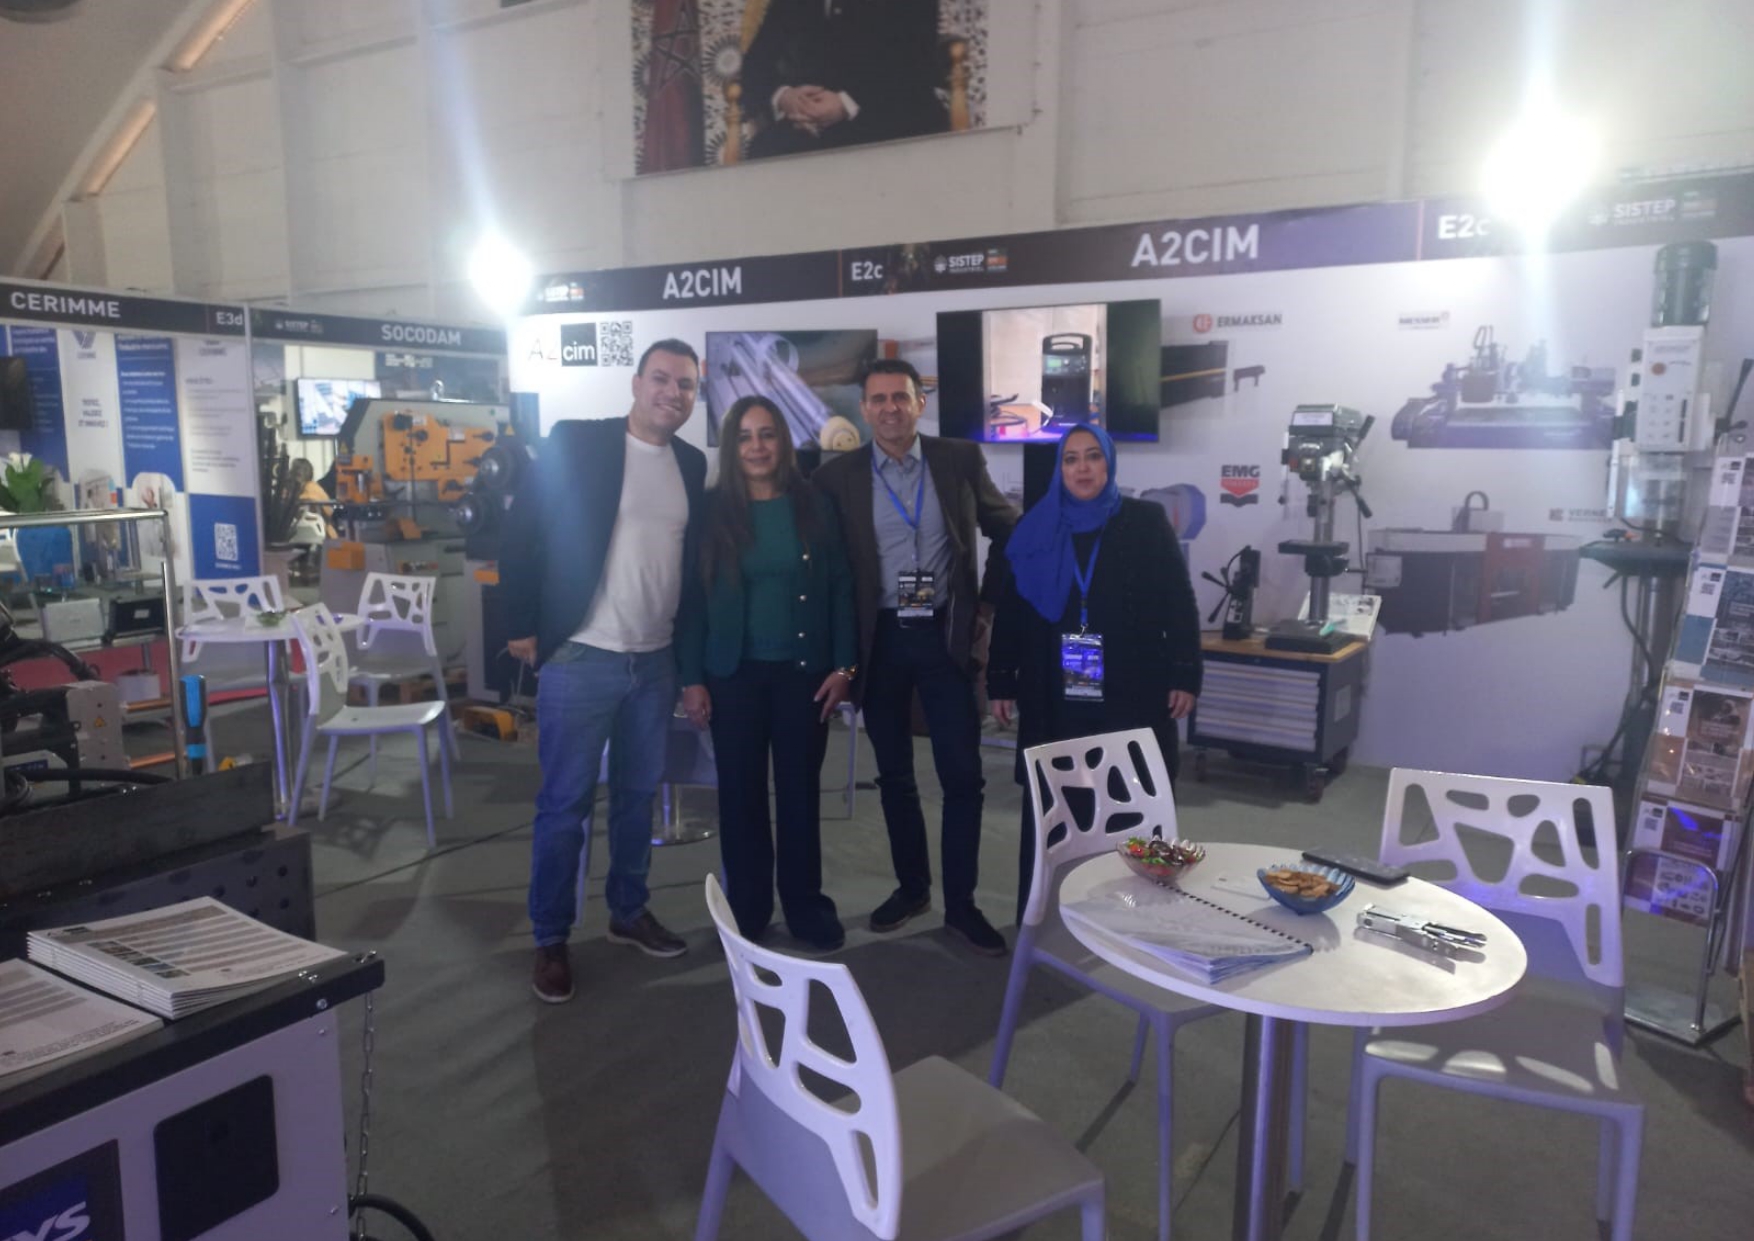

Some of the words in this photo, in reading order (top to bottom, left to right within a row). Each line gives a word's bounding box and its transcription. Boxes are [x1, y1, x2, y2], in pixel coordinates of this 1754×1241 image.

[1438, 213, 1491, 239] E2c
[1131, 224, 1260, 267] A2CIM
[851, 260, 884, 281] E2c
[662, 266, 742, 299] A2CIM
[10, 291, 121, 319] CERIMME
[216, 311, 243, 326] E3d
[1217, 313, 1283, 328] ERMAKSAN
[381, 323, 462, 346] SOCODAM
[1220, 464, 1261, 478] EMG
